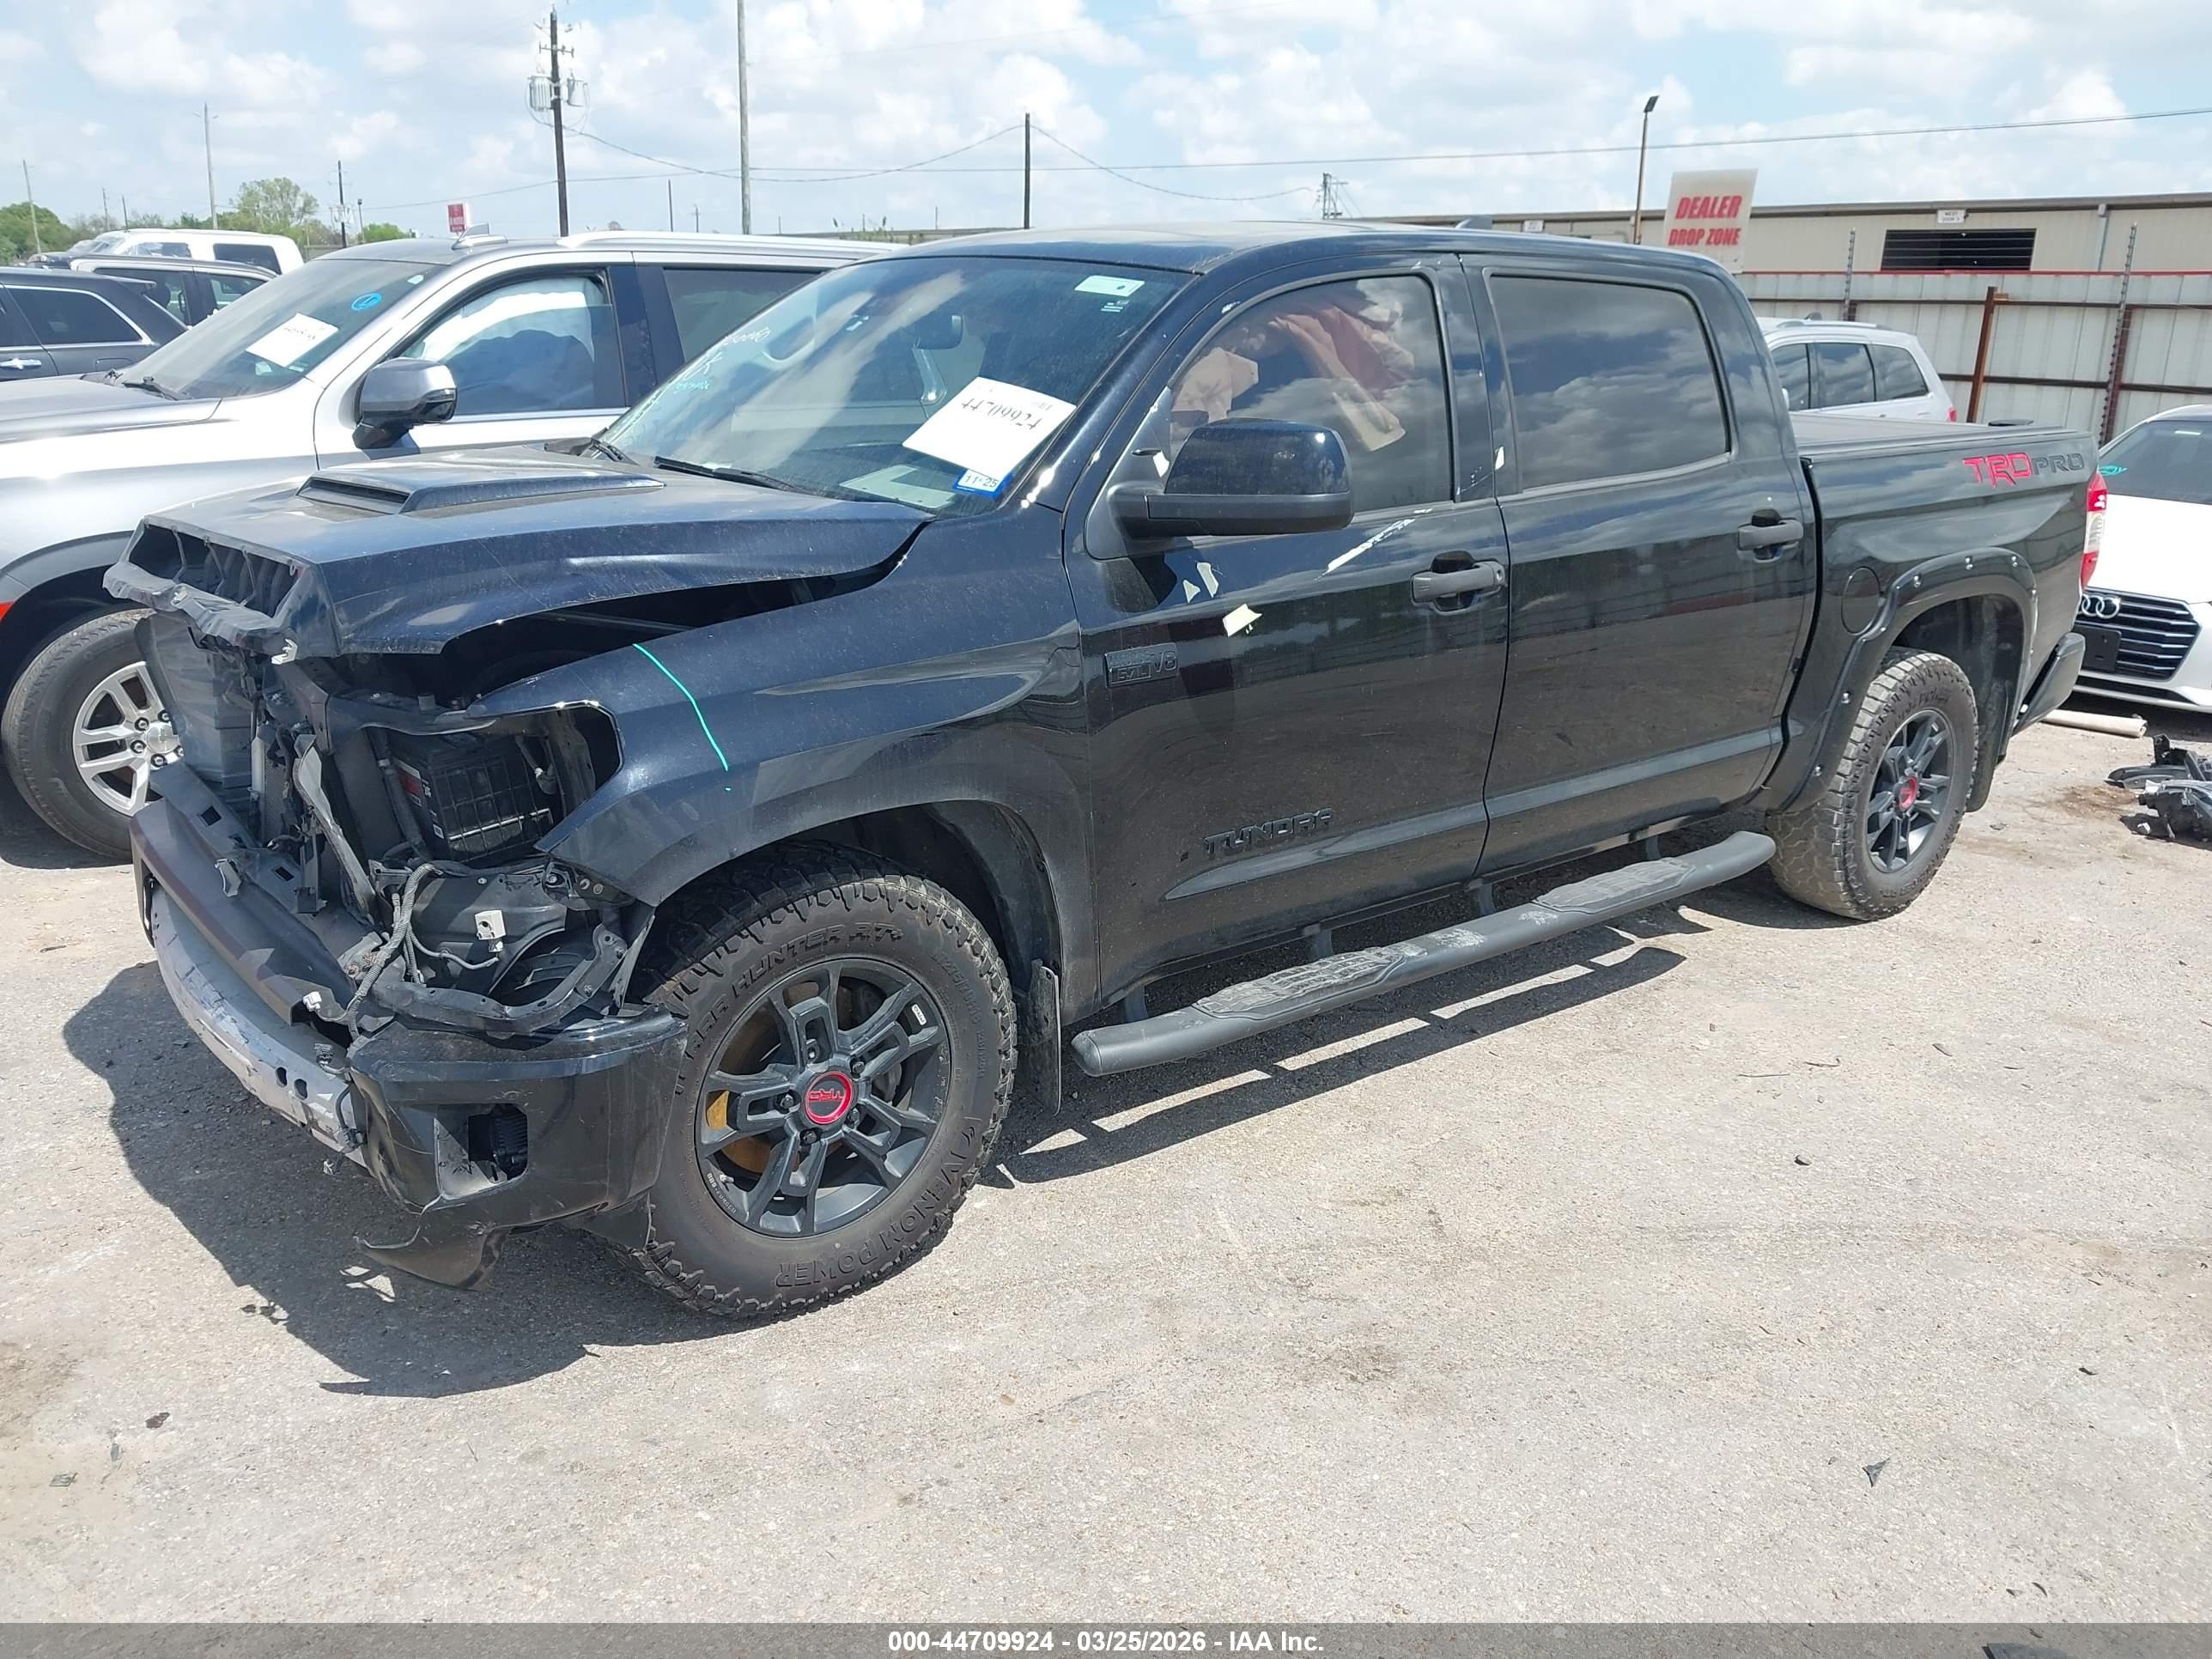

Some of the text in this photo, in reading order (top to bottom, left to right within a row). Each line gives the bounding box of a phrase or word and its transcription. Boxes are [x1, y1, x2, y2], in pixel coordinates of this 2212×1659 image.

[1674, 195, 1742, 219] DEALER
[1668, 228, 1741, 246] DROP ZONE
[1203, 807, 1334, 857] TUNDRA
[732, 922, 846, 1000] HUNTER
[775, 1159, 963, 1288] VENOM POWER
